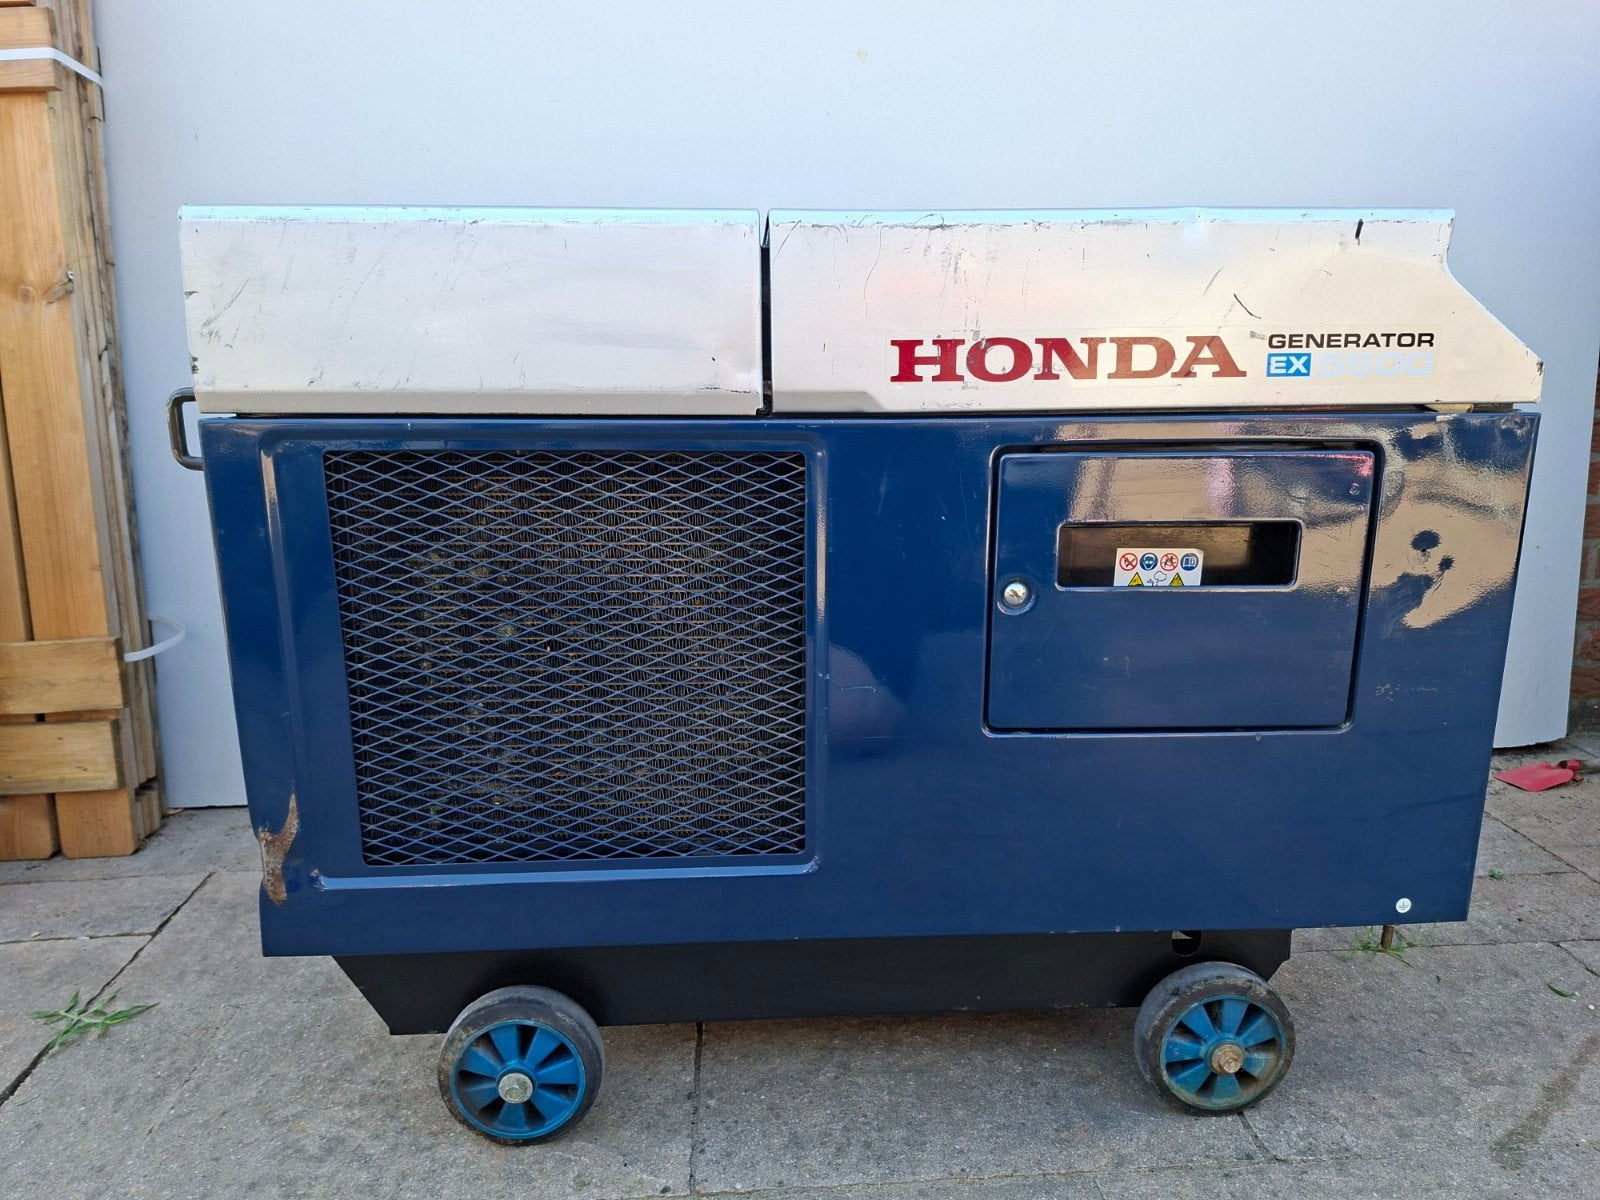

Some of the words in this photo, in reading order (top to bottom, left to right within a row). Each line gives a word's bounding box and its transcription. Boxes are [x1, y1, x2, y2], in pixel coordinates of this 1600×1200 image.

[1268, 332, 1435, 349] GENERATOR
[890, 336, 1247, 383] HONDA
[1268, 354, 1310, 375] EX
